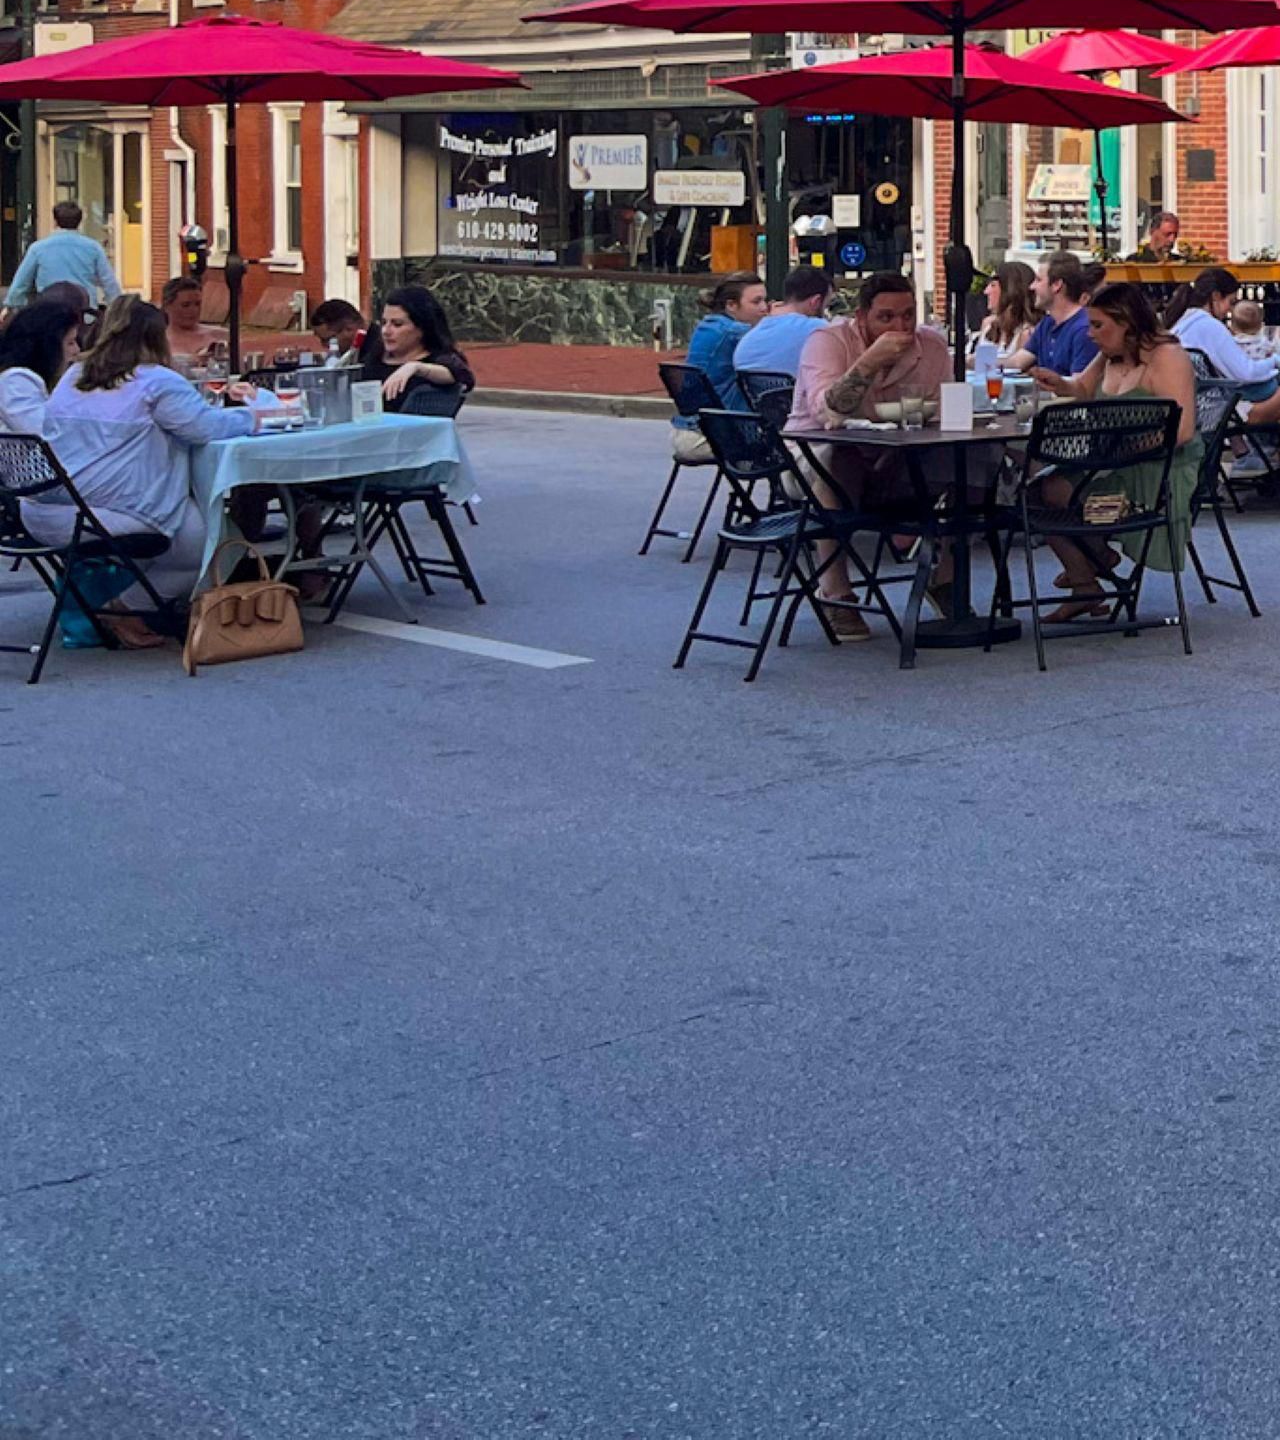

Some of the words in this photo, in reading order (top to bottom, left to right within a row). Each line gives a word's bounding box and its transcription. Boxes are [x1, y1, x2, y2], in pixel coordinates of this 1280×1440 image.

[591, 144, 643, 166] PREMIER
[488, 164, 507, 182] and
[456, 189, 488, 216] Weight
[489, 192, 509, 209] Loss
[509, 192, 539, 215] Center
[457, 220, 539, 242] 610-429-9002
